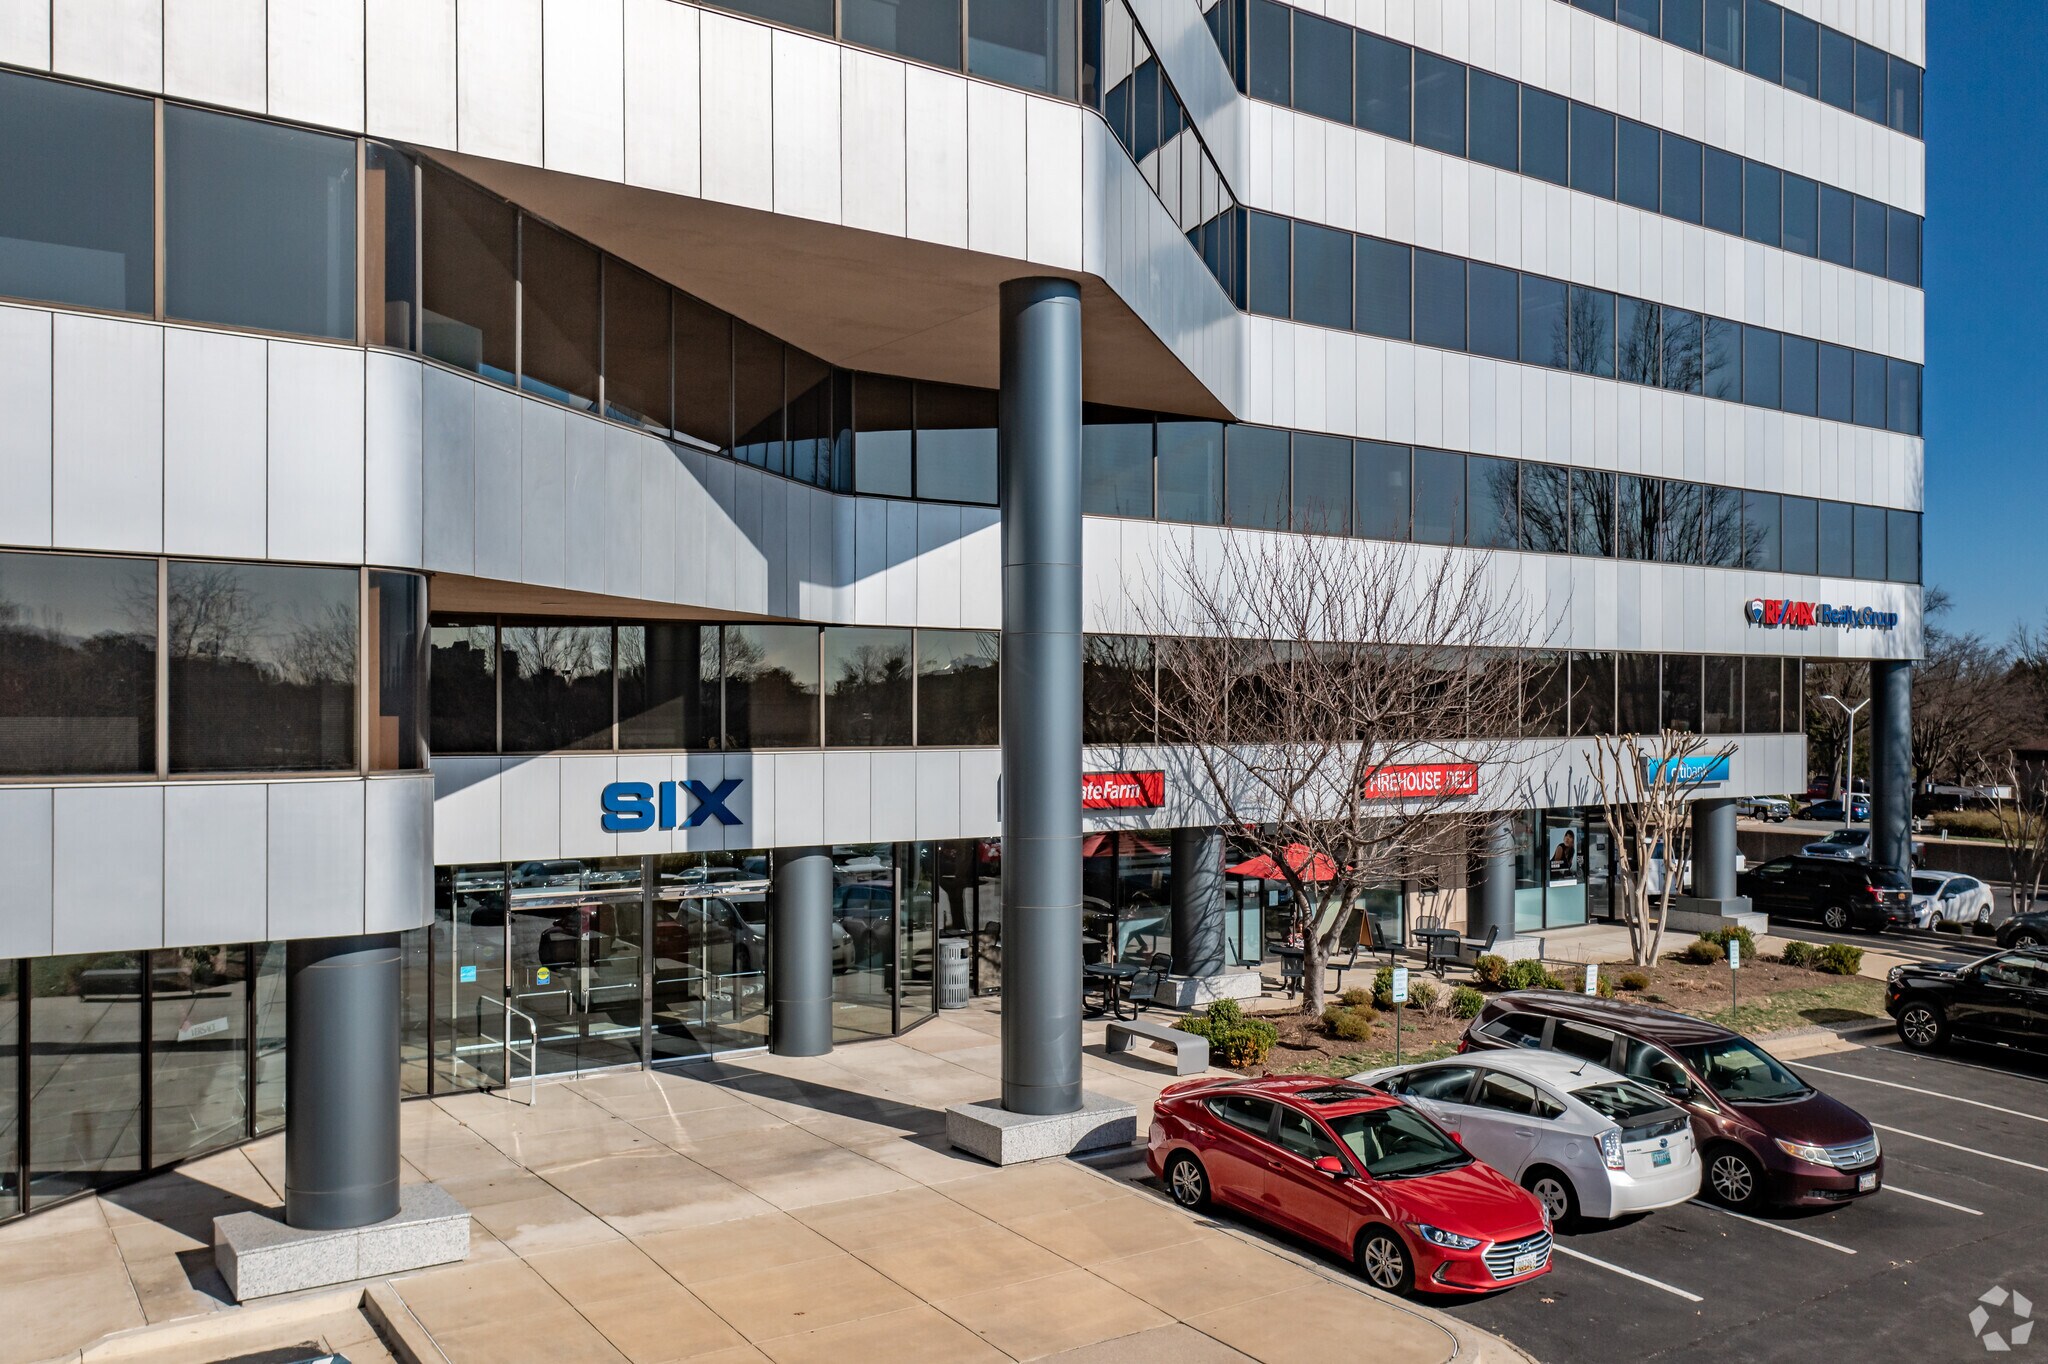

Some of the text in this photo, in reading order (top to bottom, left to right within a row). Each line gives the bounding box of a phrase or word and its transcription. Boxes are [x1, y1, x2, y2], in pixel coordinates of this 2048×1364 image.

[1764, 599, 1898, 631] RE/MAX Realty Group
[601, 778, 744, 833] SIX
